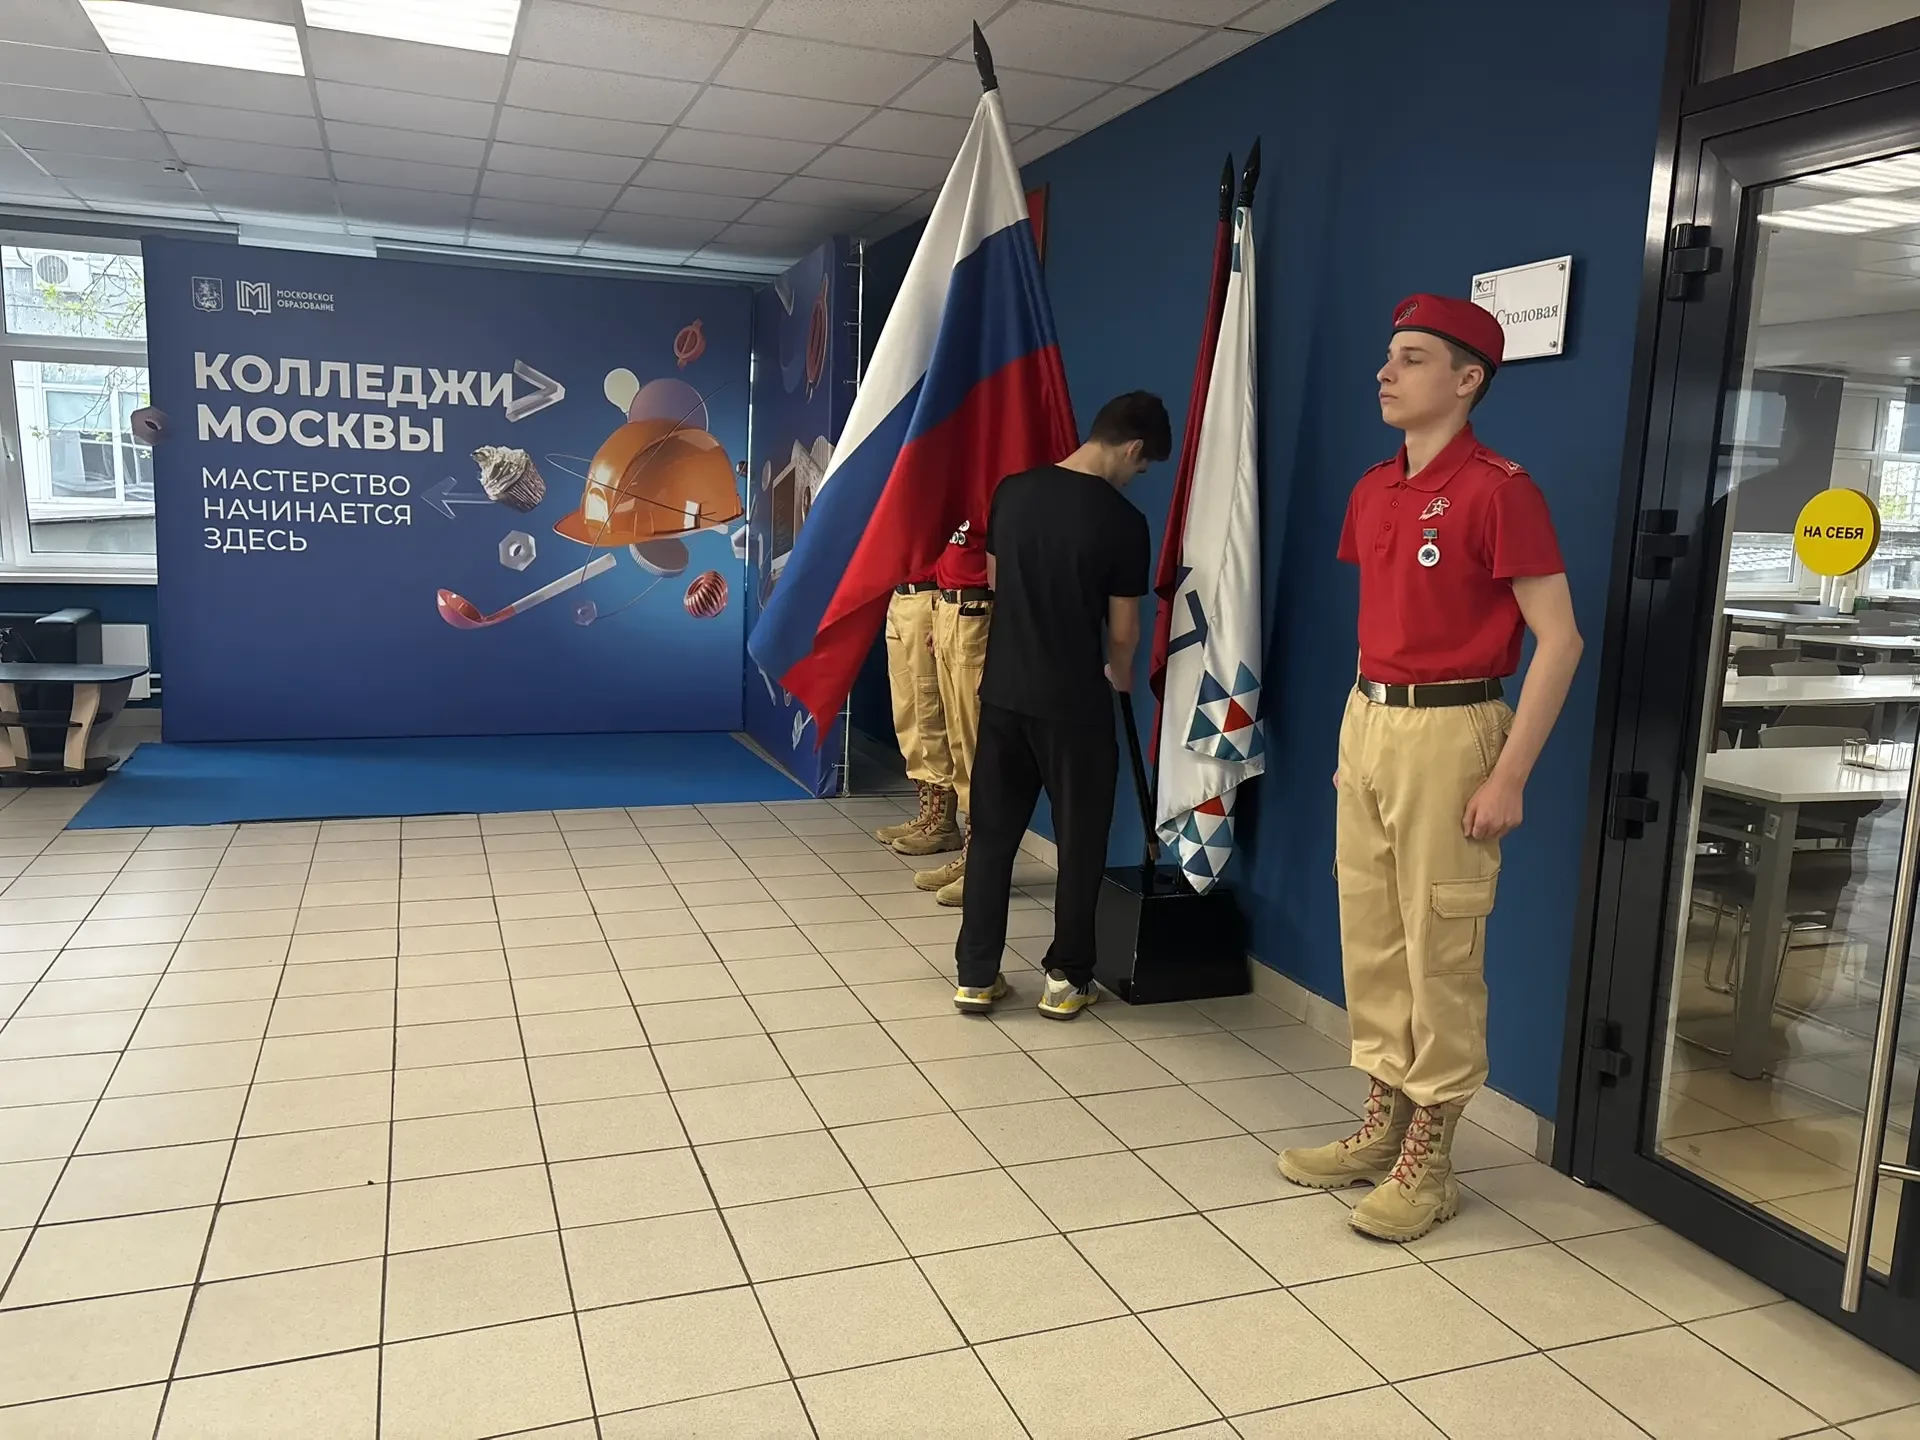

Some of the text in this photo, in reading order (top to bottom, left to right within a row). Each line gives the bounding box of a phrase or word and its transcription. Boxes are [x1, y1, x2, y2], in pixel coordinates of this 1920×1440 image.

[277, 289, 335, 302] МОСКОВСКОЕ
[277, 299, 335, 312] ОБРАЗОВАНИЕ
[1495, 304, 1559, 326] Столовая
[194, 351, 513, 410] КОЛЛЕДЖИ
[196, 403, 444, 453] МОСКВЫ
[202, 466, 411, 497] МАСТЕРСТВО
[203, 497, 412, 526] НАЧИНАЕТСЯ
[203, 527, 308, 554] ЗДЕСЬ
[1803, 525, 1864, 540] НА СЕБЯ
